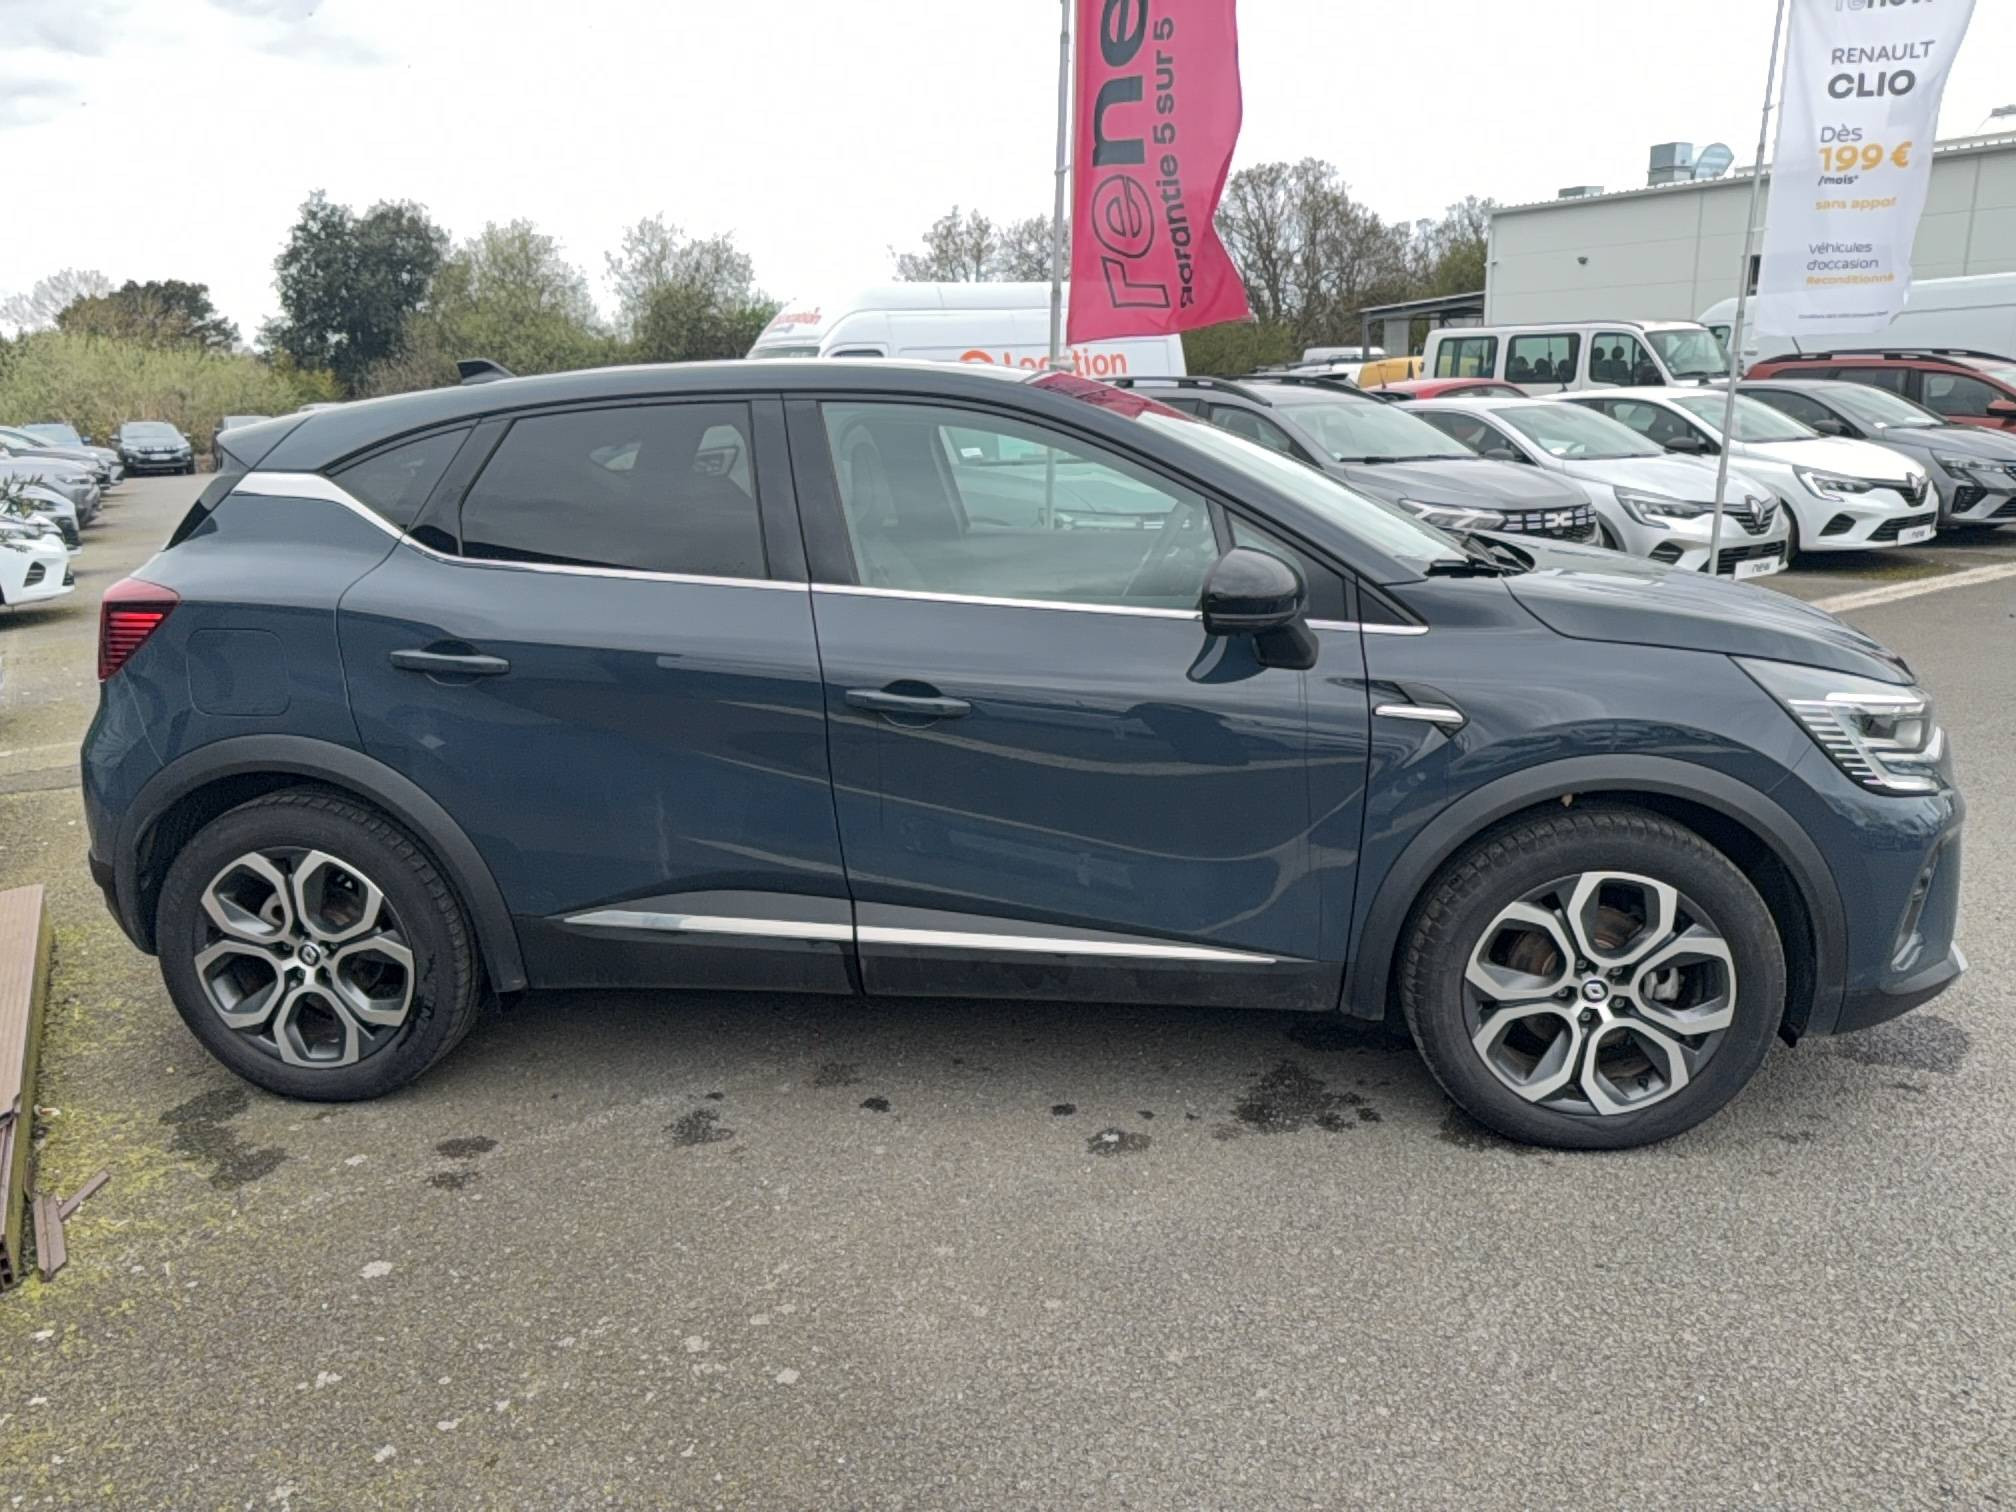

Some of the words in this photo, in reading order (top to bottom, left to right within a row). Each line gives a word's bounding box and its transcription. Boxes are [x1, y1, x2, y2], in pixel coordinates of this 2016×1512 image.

[1152, 16, 1174, 41] 5
[1831, 39, 1936, 65] RENAULT
[1154, 50, 1175, 115] sur
[1827, 69, 1916, 99] CLIO
[1153, 122, 1175, 145] 5
[1820, 123, 1863, 143] Dès
[1818, 144, 1884, 172] 199
[1890, 141, 1913, 168] €
[1156, 154, 1195, 308] garantie
[1806, 258, 1879, 271] d'occasion
[1004, 348, 1127, 377] tion
